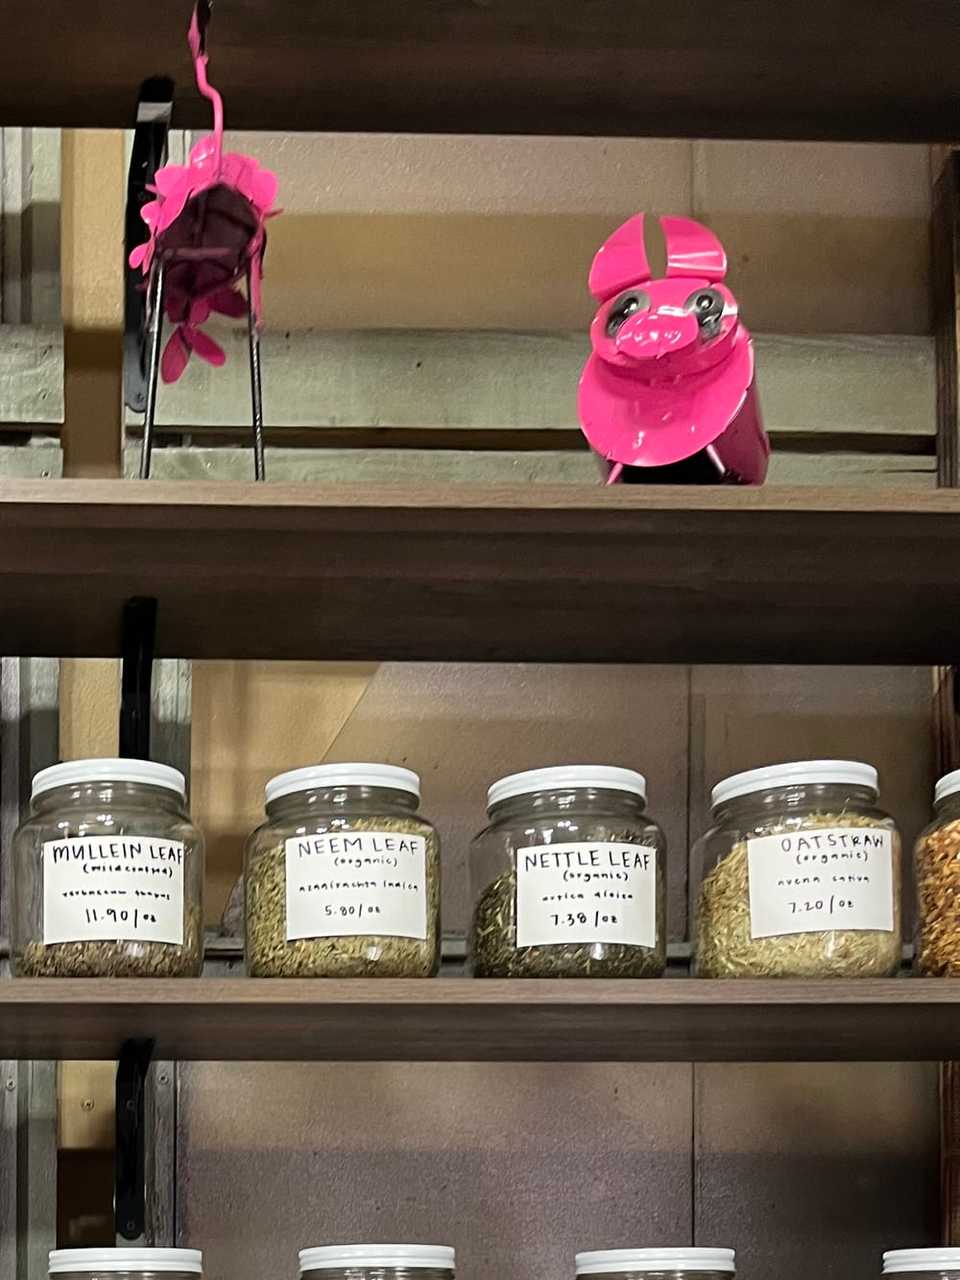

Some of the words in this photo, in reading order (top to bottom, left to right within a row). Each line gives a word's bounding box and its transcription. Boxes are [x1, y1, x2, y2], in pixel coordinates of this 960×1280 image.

[52, 842, 142, 865] MULLEIN
[148, 844, 183, 866] LEAF
[298, 837, 363, 859] NEEM
[371, 837, 419, 853] LEAF
[524, 849, 601, 873] NETTLE
[608, 850, 651, 868] LEAF
